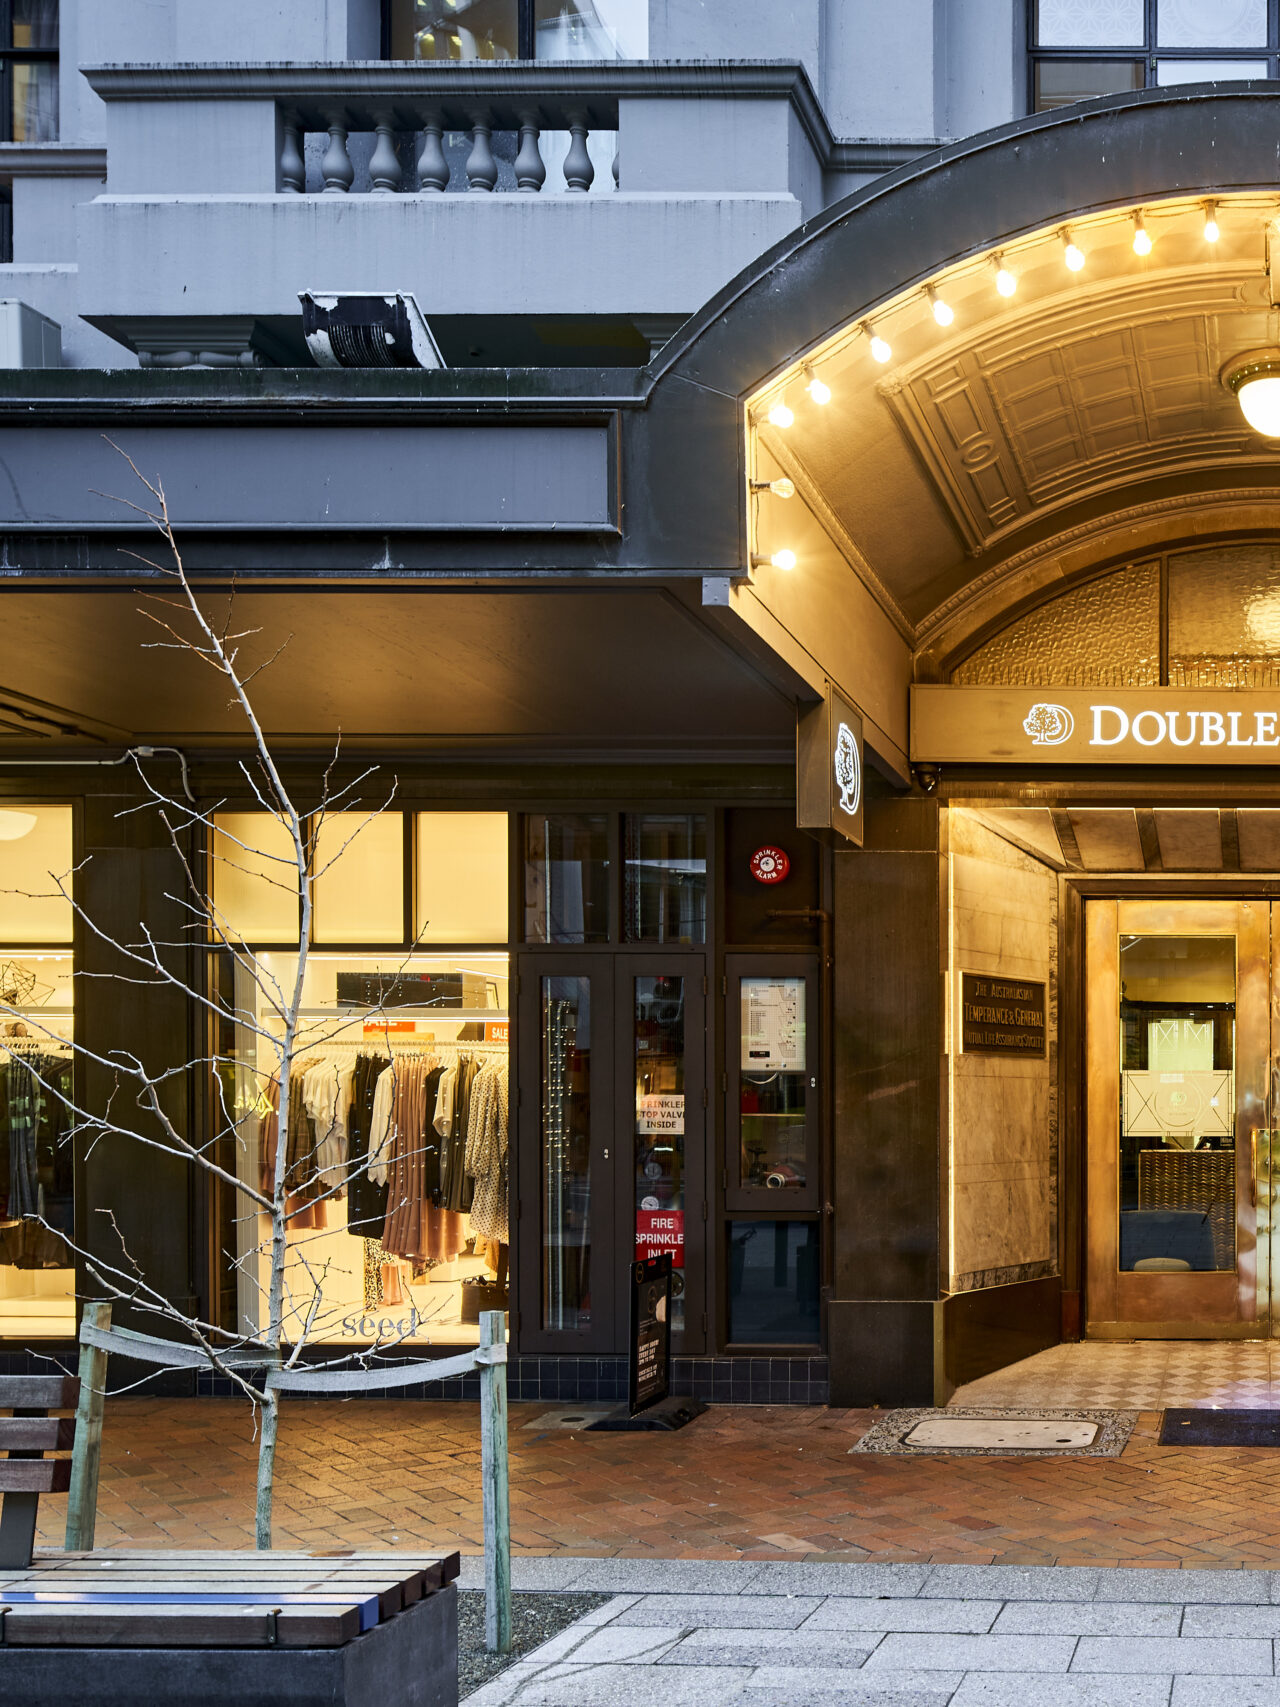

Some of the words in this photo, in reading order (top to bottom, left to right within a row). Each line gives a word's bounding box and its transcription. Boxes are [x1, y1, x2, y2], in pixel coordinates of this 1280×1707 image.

[753, 849, 783, 870] SPRINKLER
[755, 870, 778, 879] ALARM
[964, 1002, 1009, 1025] TEMPERANCE
[1015, 1007, 1044, 1027] GENERAL
[491, 1027, 508, 1040] SALE
[660, 1111, 685, 1119] VALV
[646, 1121, 677, 1129] INSIDE
[650, 1217, 674, 1229] FIRE
[635, 1233, 684, 1245] SPRINKLE
[341, 1308, 416, 1337] seed
